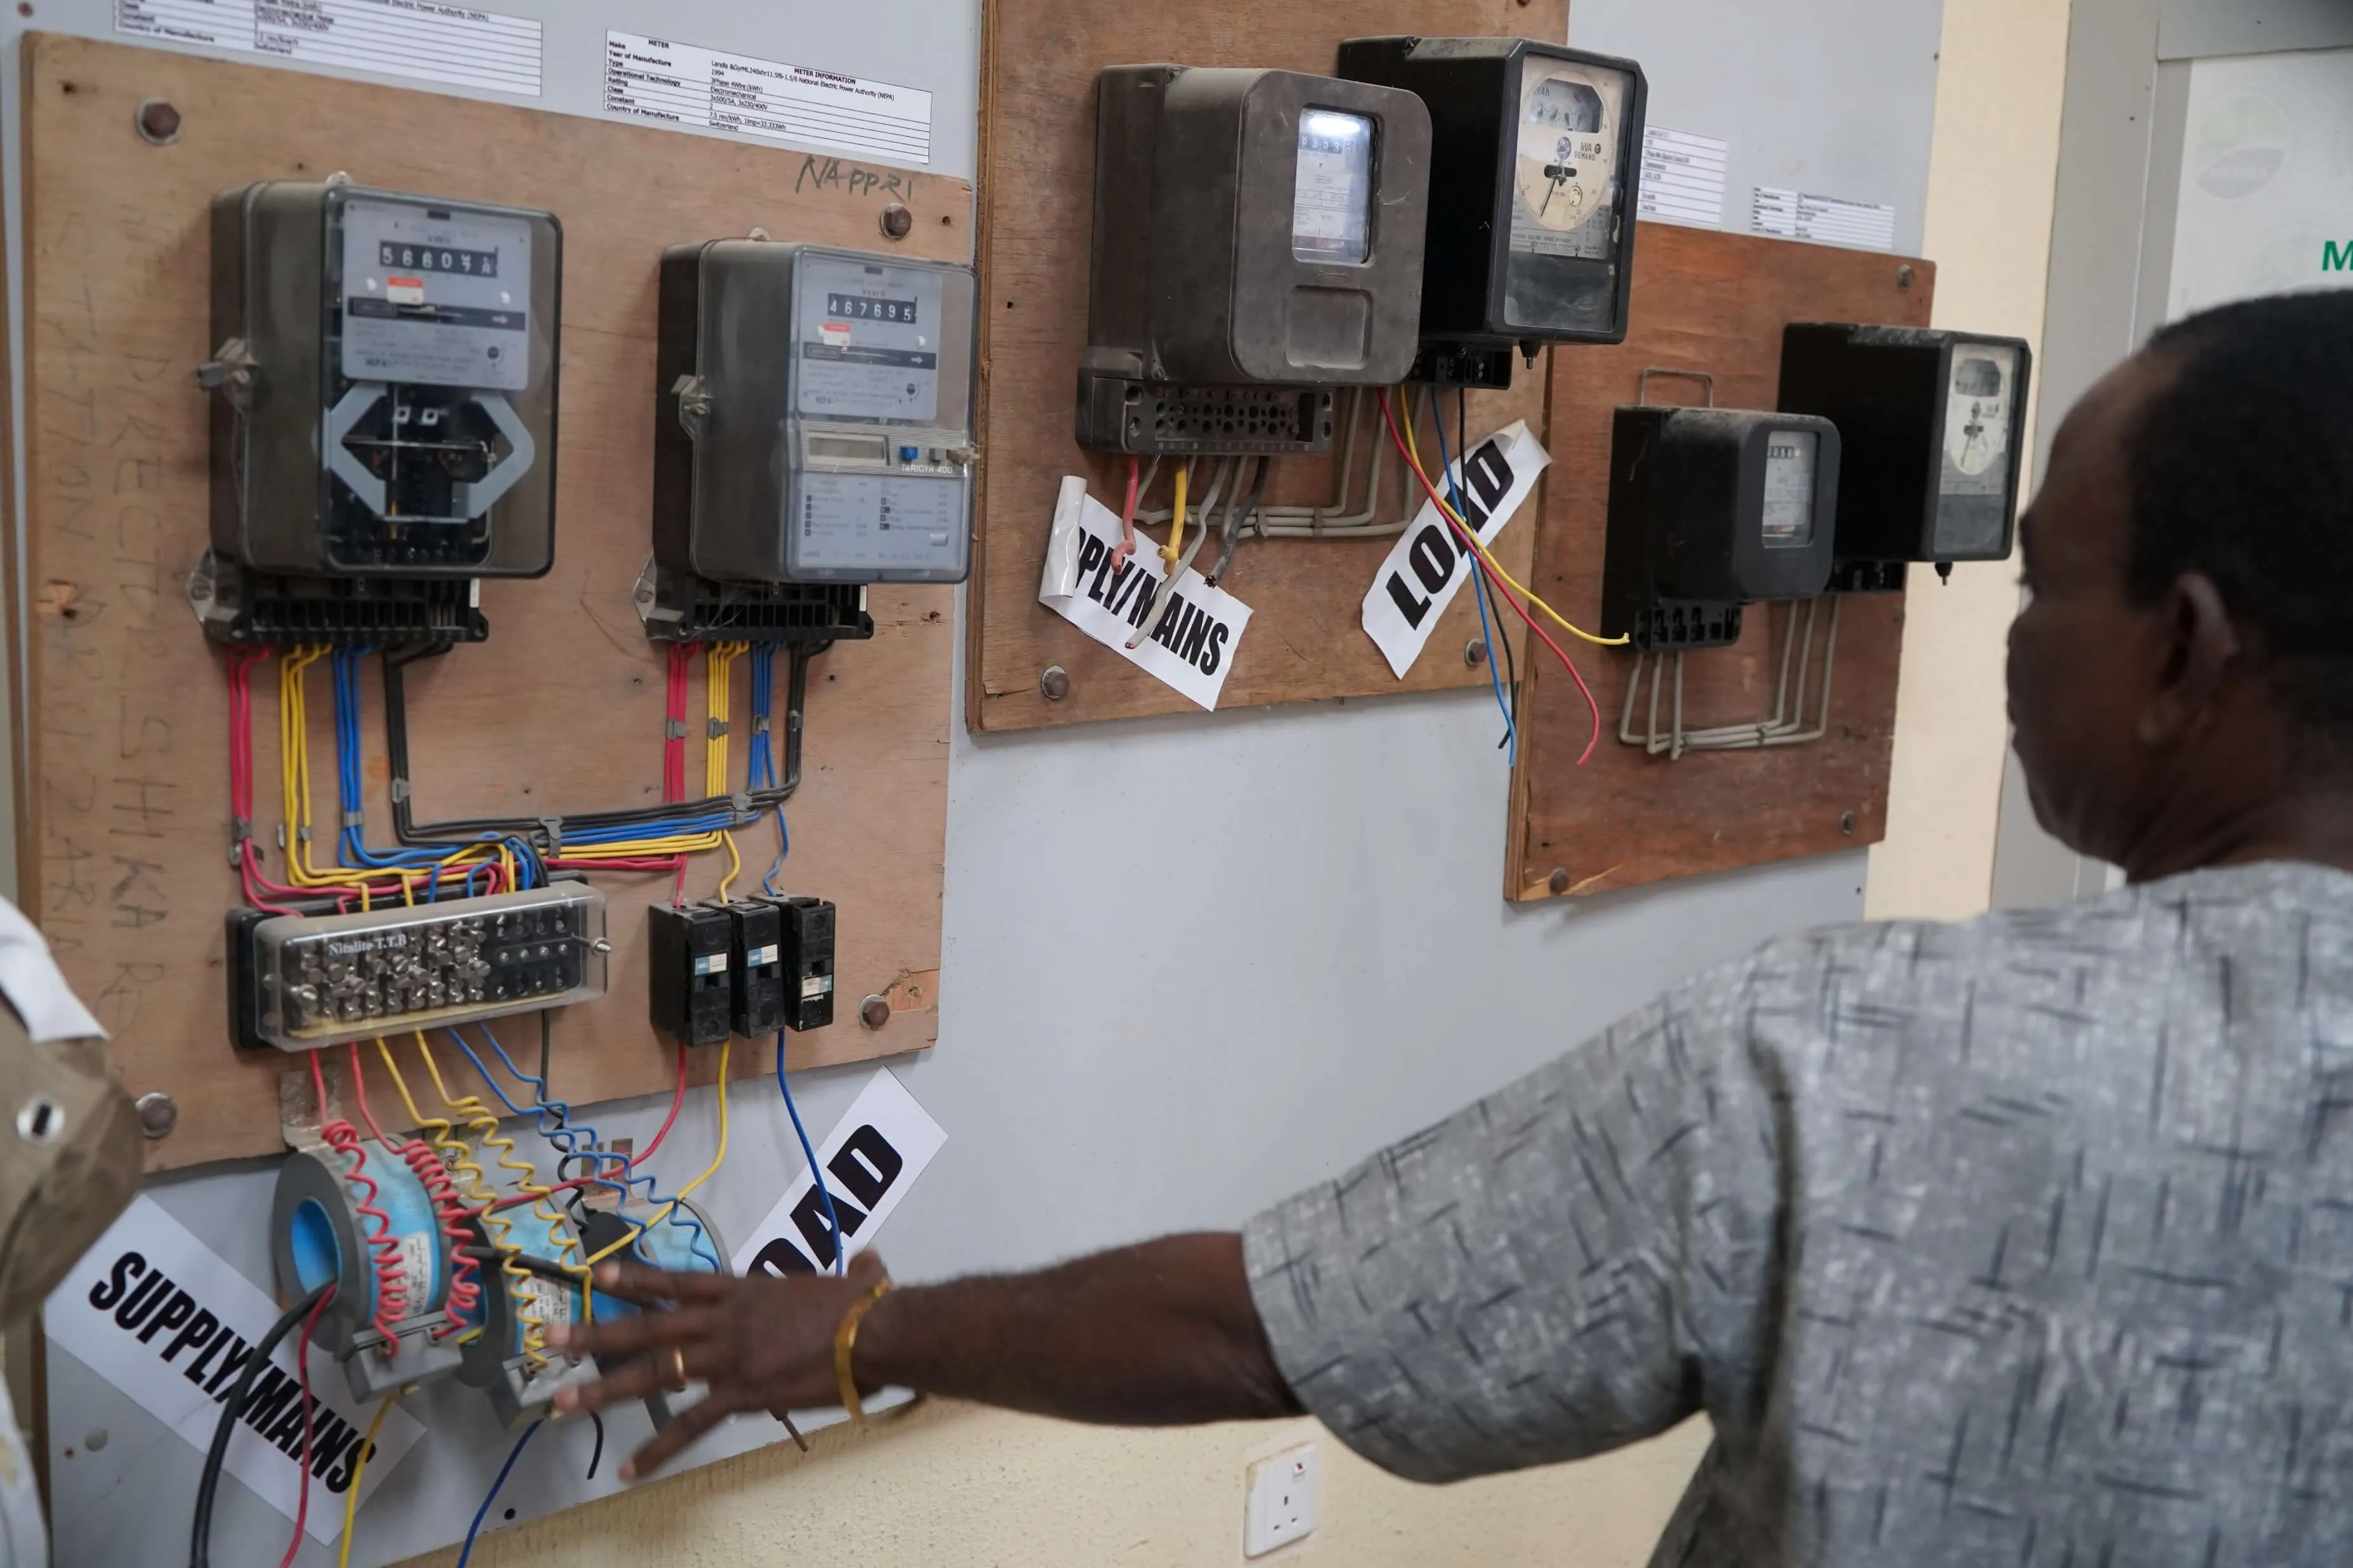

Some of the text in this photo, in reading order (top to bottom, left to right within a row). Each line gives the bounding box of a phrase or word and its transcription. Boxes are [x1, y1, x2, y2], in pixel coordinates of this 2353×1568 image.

[609, 41, 625, 49] Make
[648, 39, 670, 49] METER
[608, 58, 623, 67] Type
[609, 49, 623, 58] Year
[632, 54, 671, 67] Manufacture
[608, 67, 681, 87] Operational Technology
[711, 60, 728, 69] Landis
[798, 77, 819, 86] National
[821, 81, 838, 90] Electric
[839, 84, 854, 93] Power
[855, 87, 877, 98] Authority
[878, 91, 894, 101] (NEPA)
[794, 68, 856, 84] METER INFORMATION
[608, 77, 628, 87] Rating
[607, 85, 623, 94] Class
[710, 86, 756, 100] Electromechanical
[747, 84, 763, 93] (kWh)
[1534, 86, 1550, 97] VAh
[607, 94, 635, 105] Constant
[738, 98, 768, 110] 3x230/400V
[606, 103, 631, 113] Country
[641, 108, 679, 121] Manufacture
[708, 120, 738, 131] Switzerland
[1574, 150, 1596, 161] DEMAND
[1386, 438, 1515, 631] LOAD
